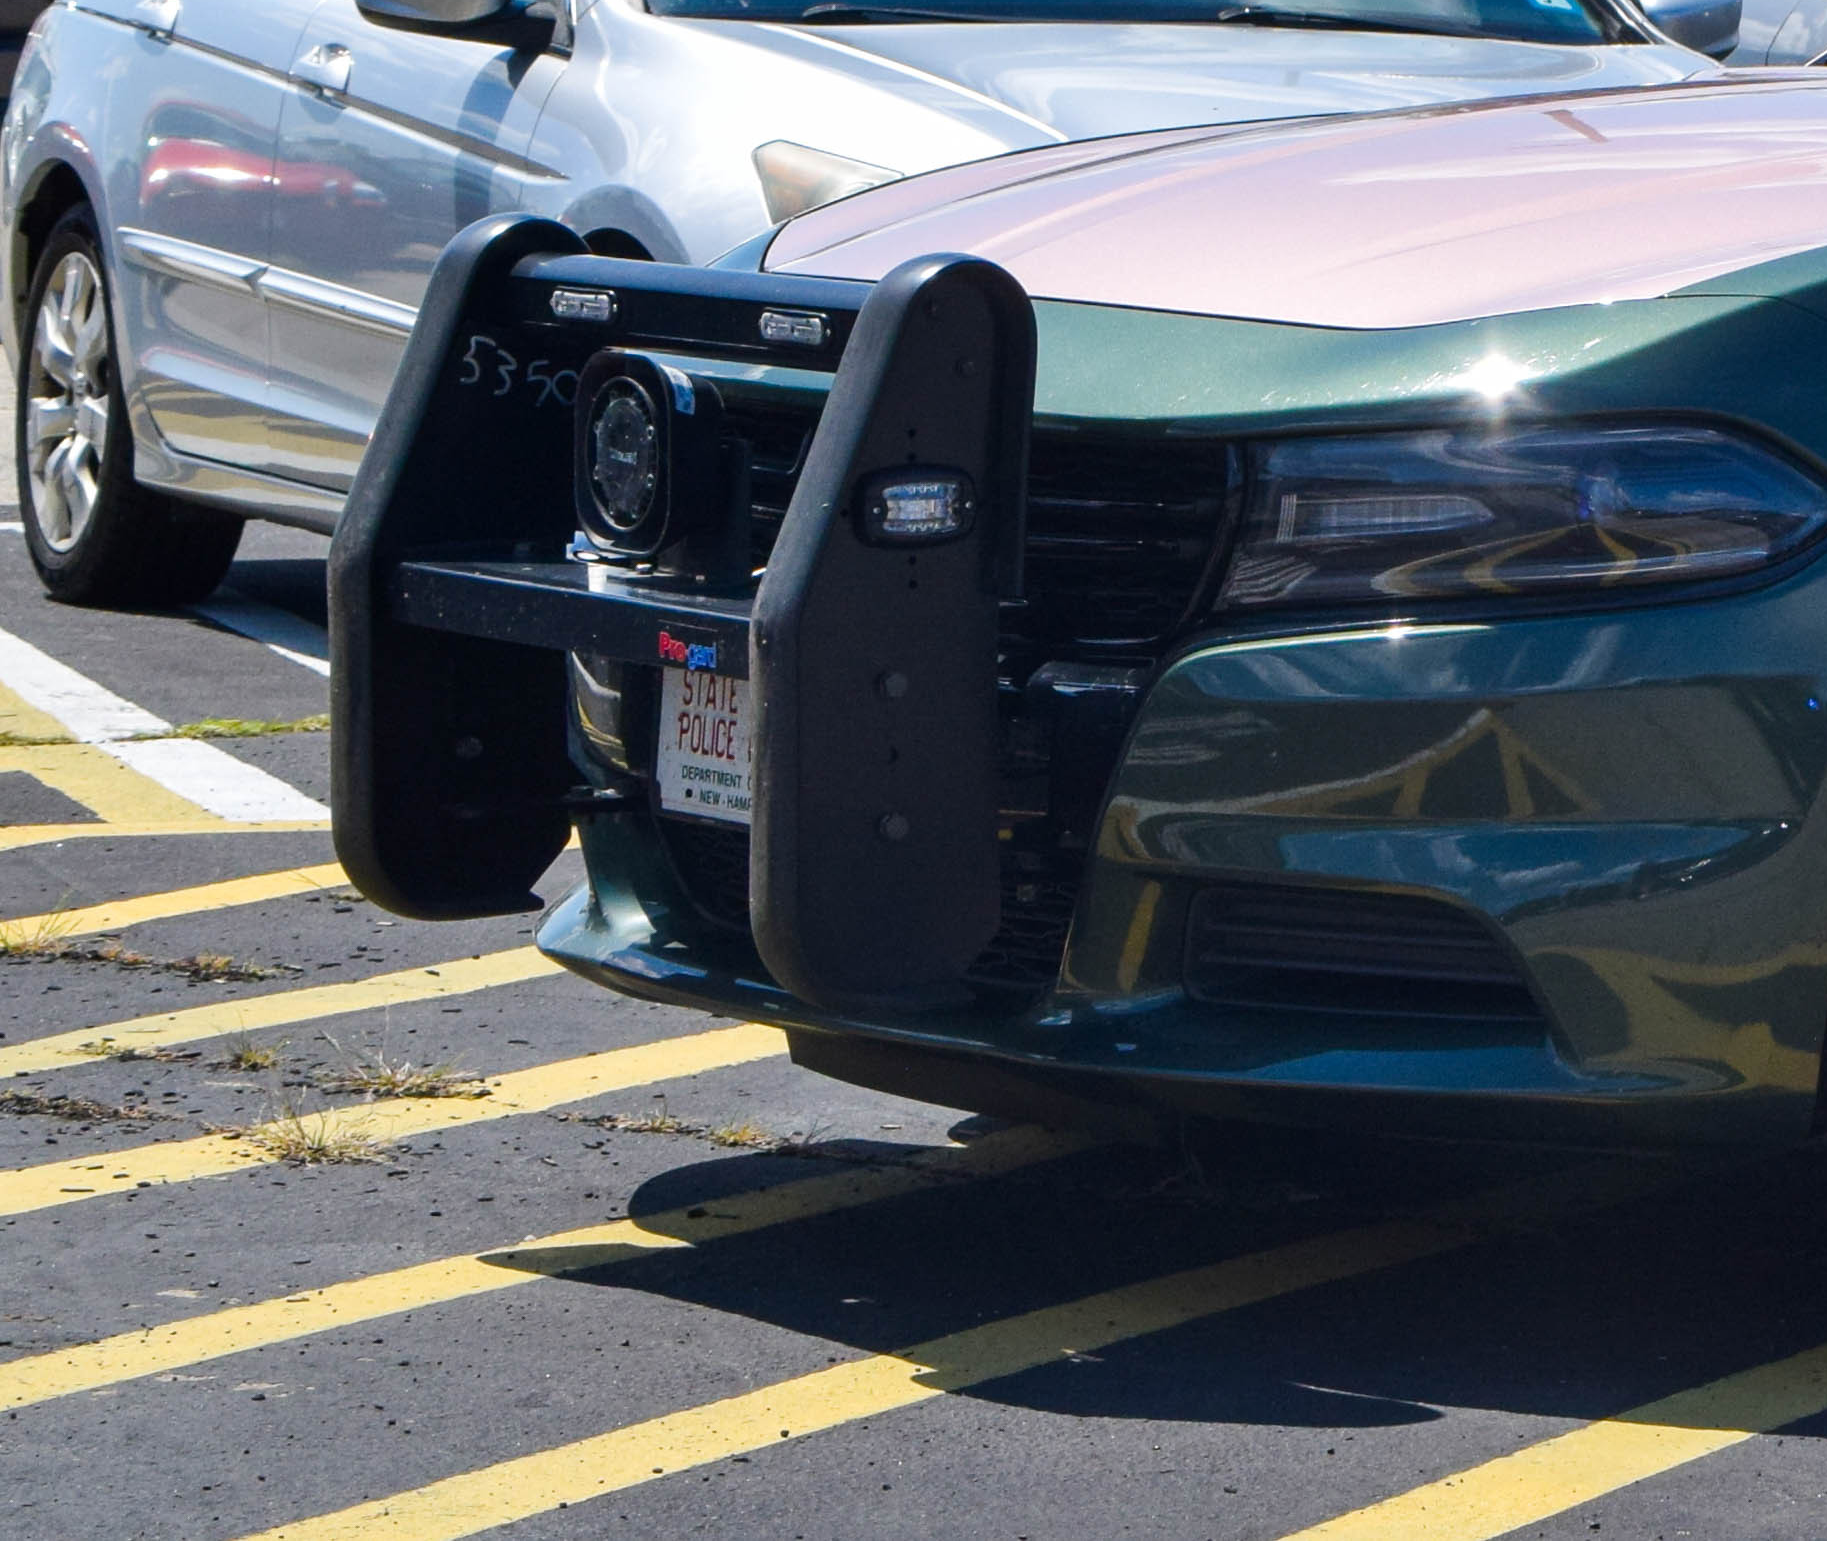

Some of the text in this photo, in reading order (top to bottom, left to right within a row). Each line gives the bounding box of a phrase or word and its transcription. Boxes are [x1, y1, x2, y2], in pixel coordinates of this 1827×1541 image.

[678, 711, 737, 760] POLICE
[681, 764, 742, 789] DEPARTMENT
[699, 789, 721, 806] NEW
